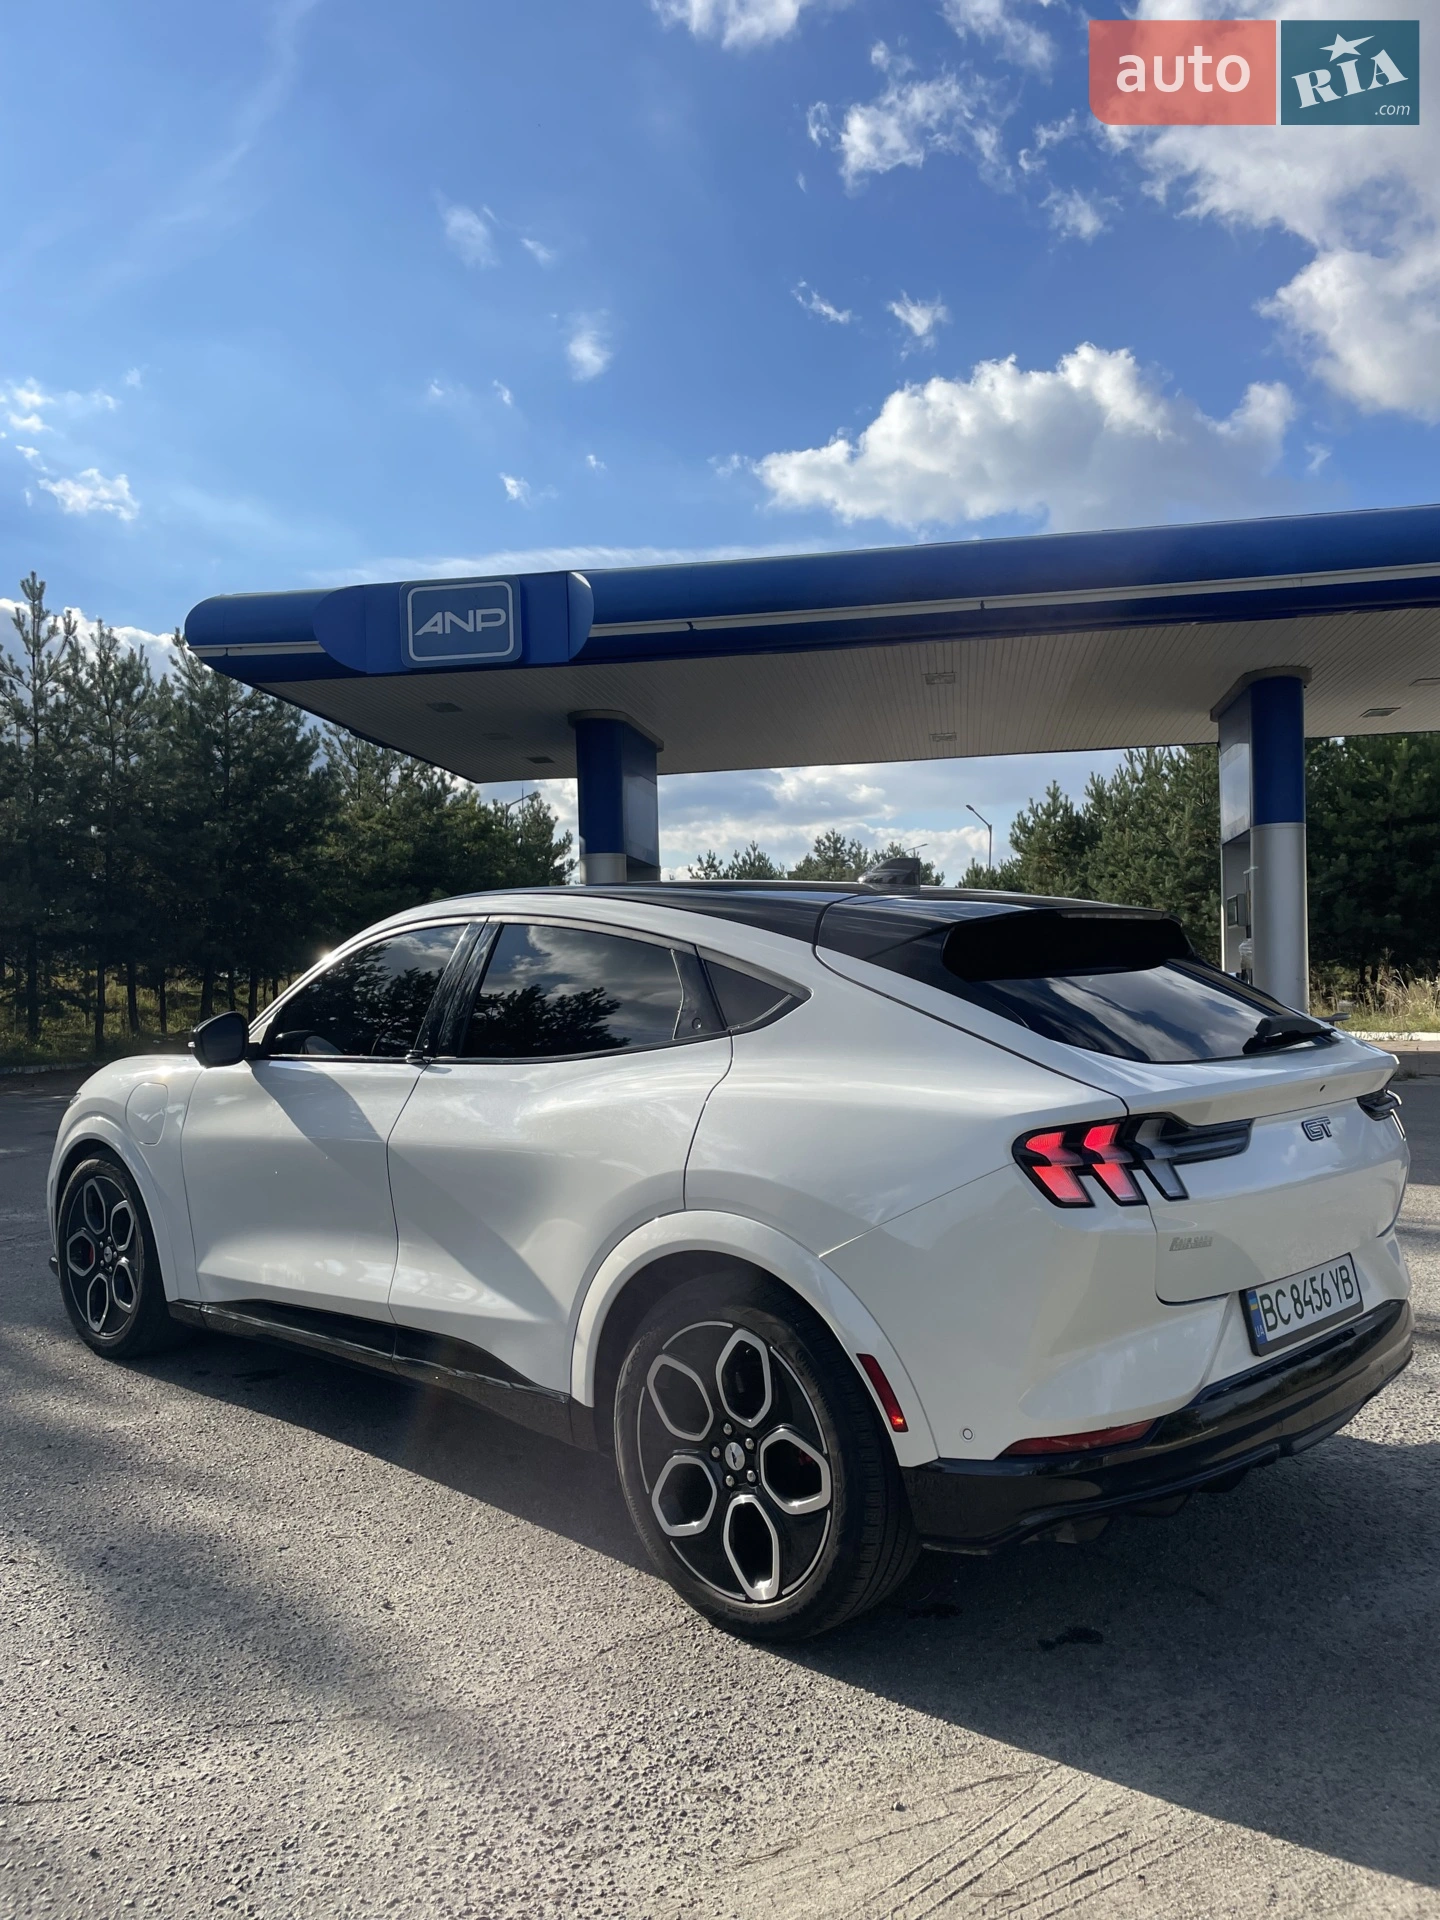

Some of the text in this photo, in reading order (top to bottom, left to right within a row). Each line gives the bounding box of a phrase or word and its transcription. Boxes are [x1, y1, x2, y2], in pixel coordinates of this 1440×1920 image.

[414, 607, 507, 636] ANP
[1301, 1116, 1332, 1141] GT
[1259, 1264, 1354, 1333] BC 8456 YB
[1255, 1324, 1266, 1338] UA
